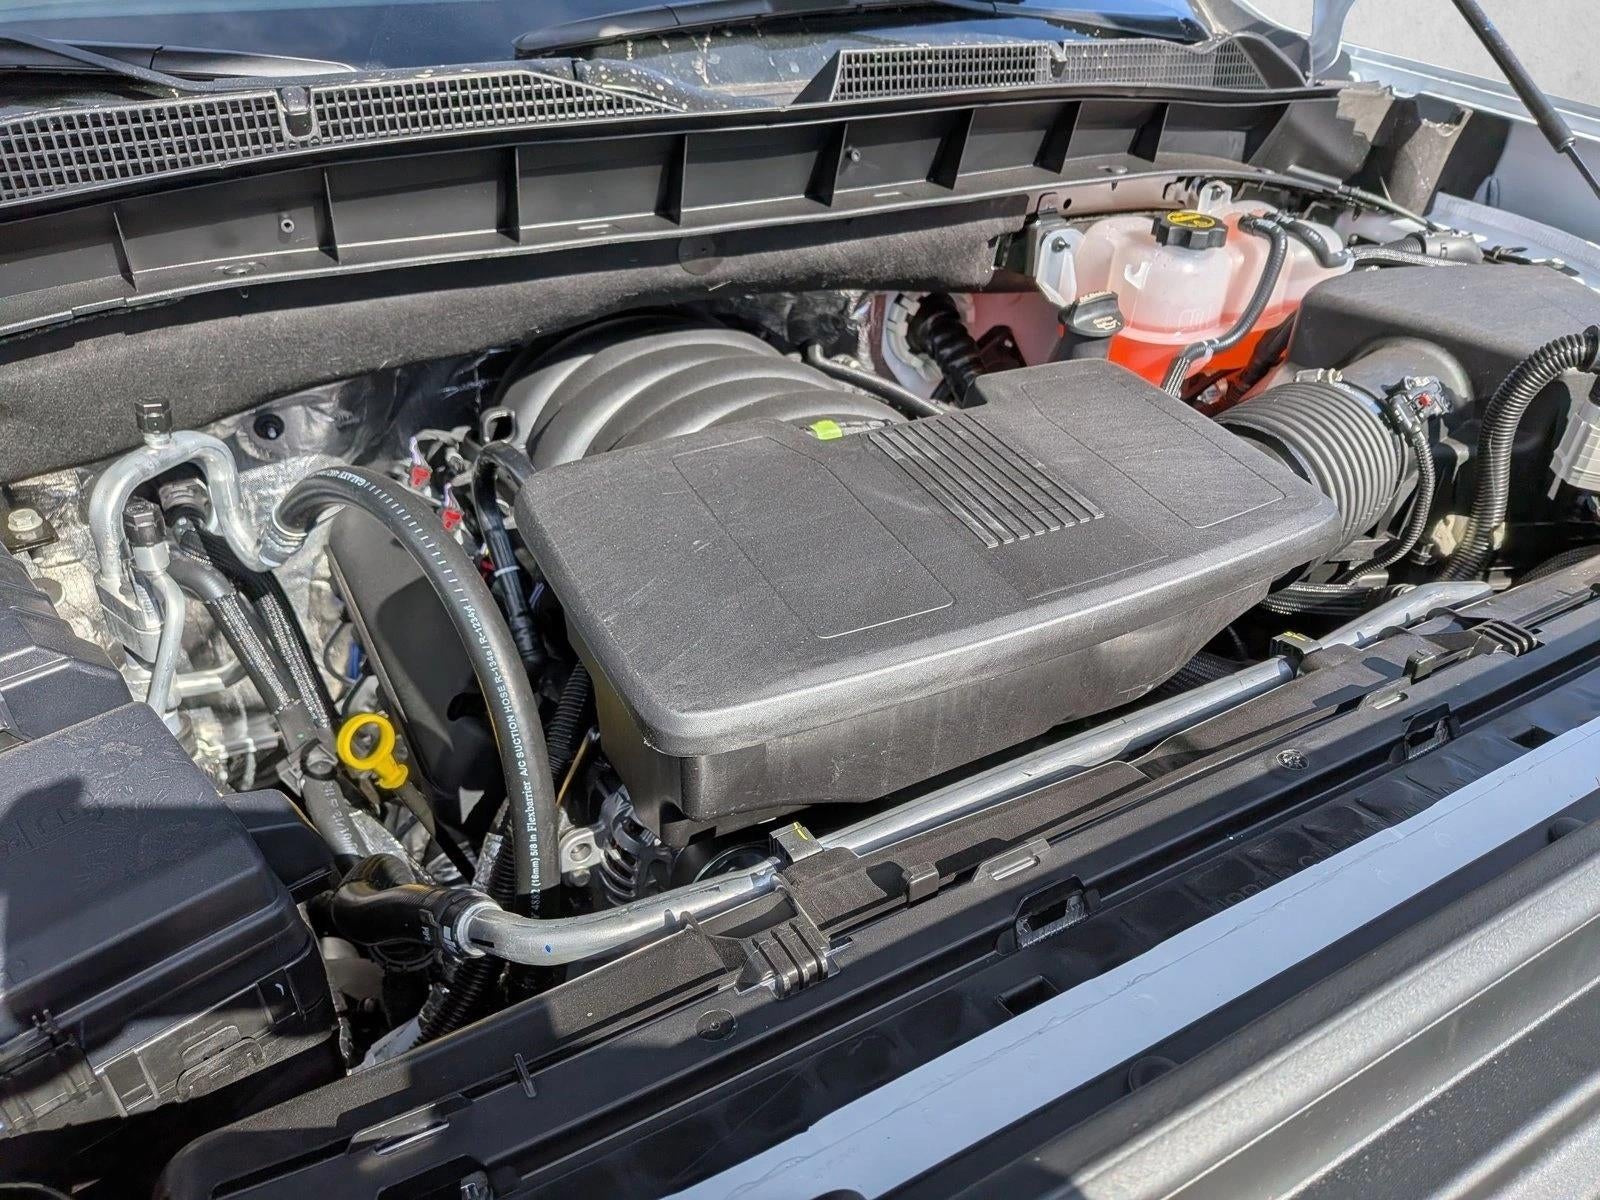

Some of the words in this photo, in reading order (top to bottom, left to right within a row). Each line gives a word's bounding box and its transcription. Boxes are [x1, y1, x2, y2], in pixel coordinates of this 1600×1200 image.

[463, 605, 488, 644] R-1234yf
[486, 650, 504, 684] R-134a
[497, 685, 513, 713] HOSE
[506, 715, 525, 759] SUCTION
[518, 760, 529, 776] A/C
[522, 781, 538, 832] Flexbarrier
[529, 843, 539, 856] 5/8
[530, 857, 541, 887] (16mm)
